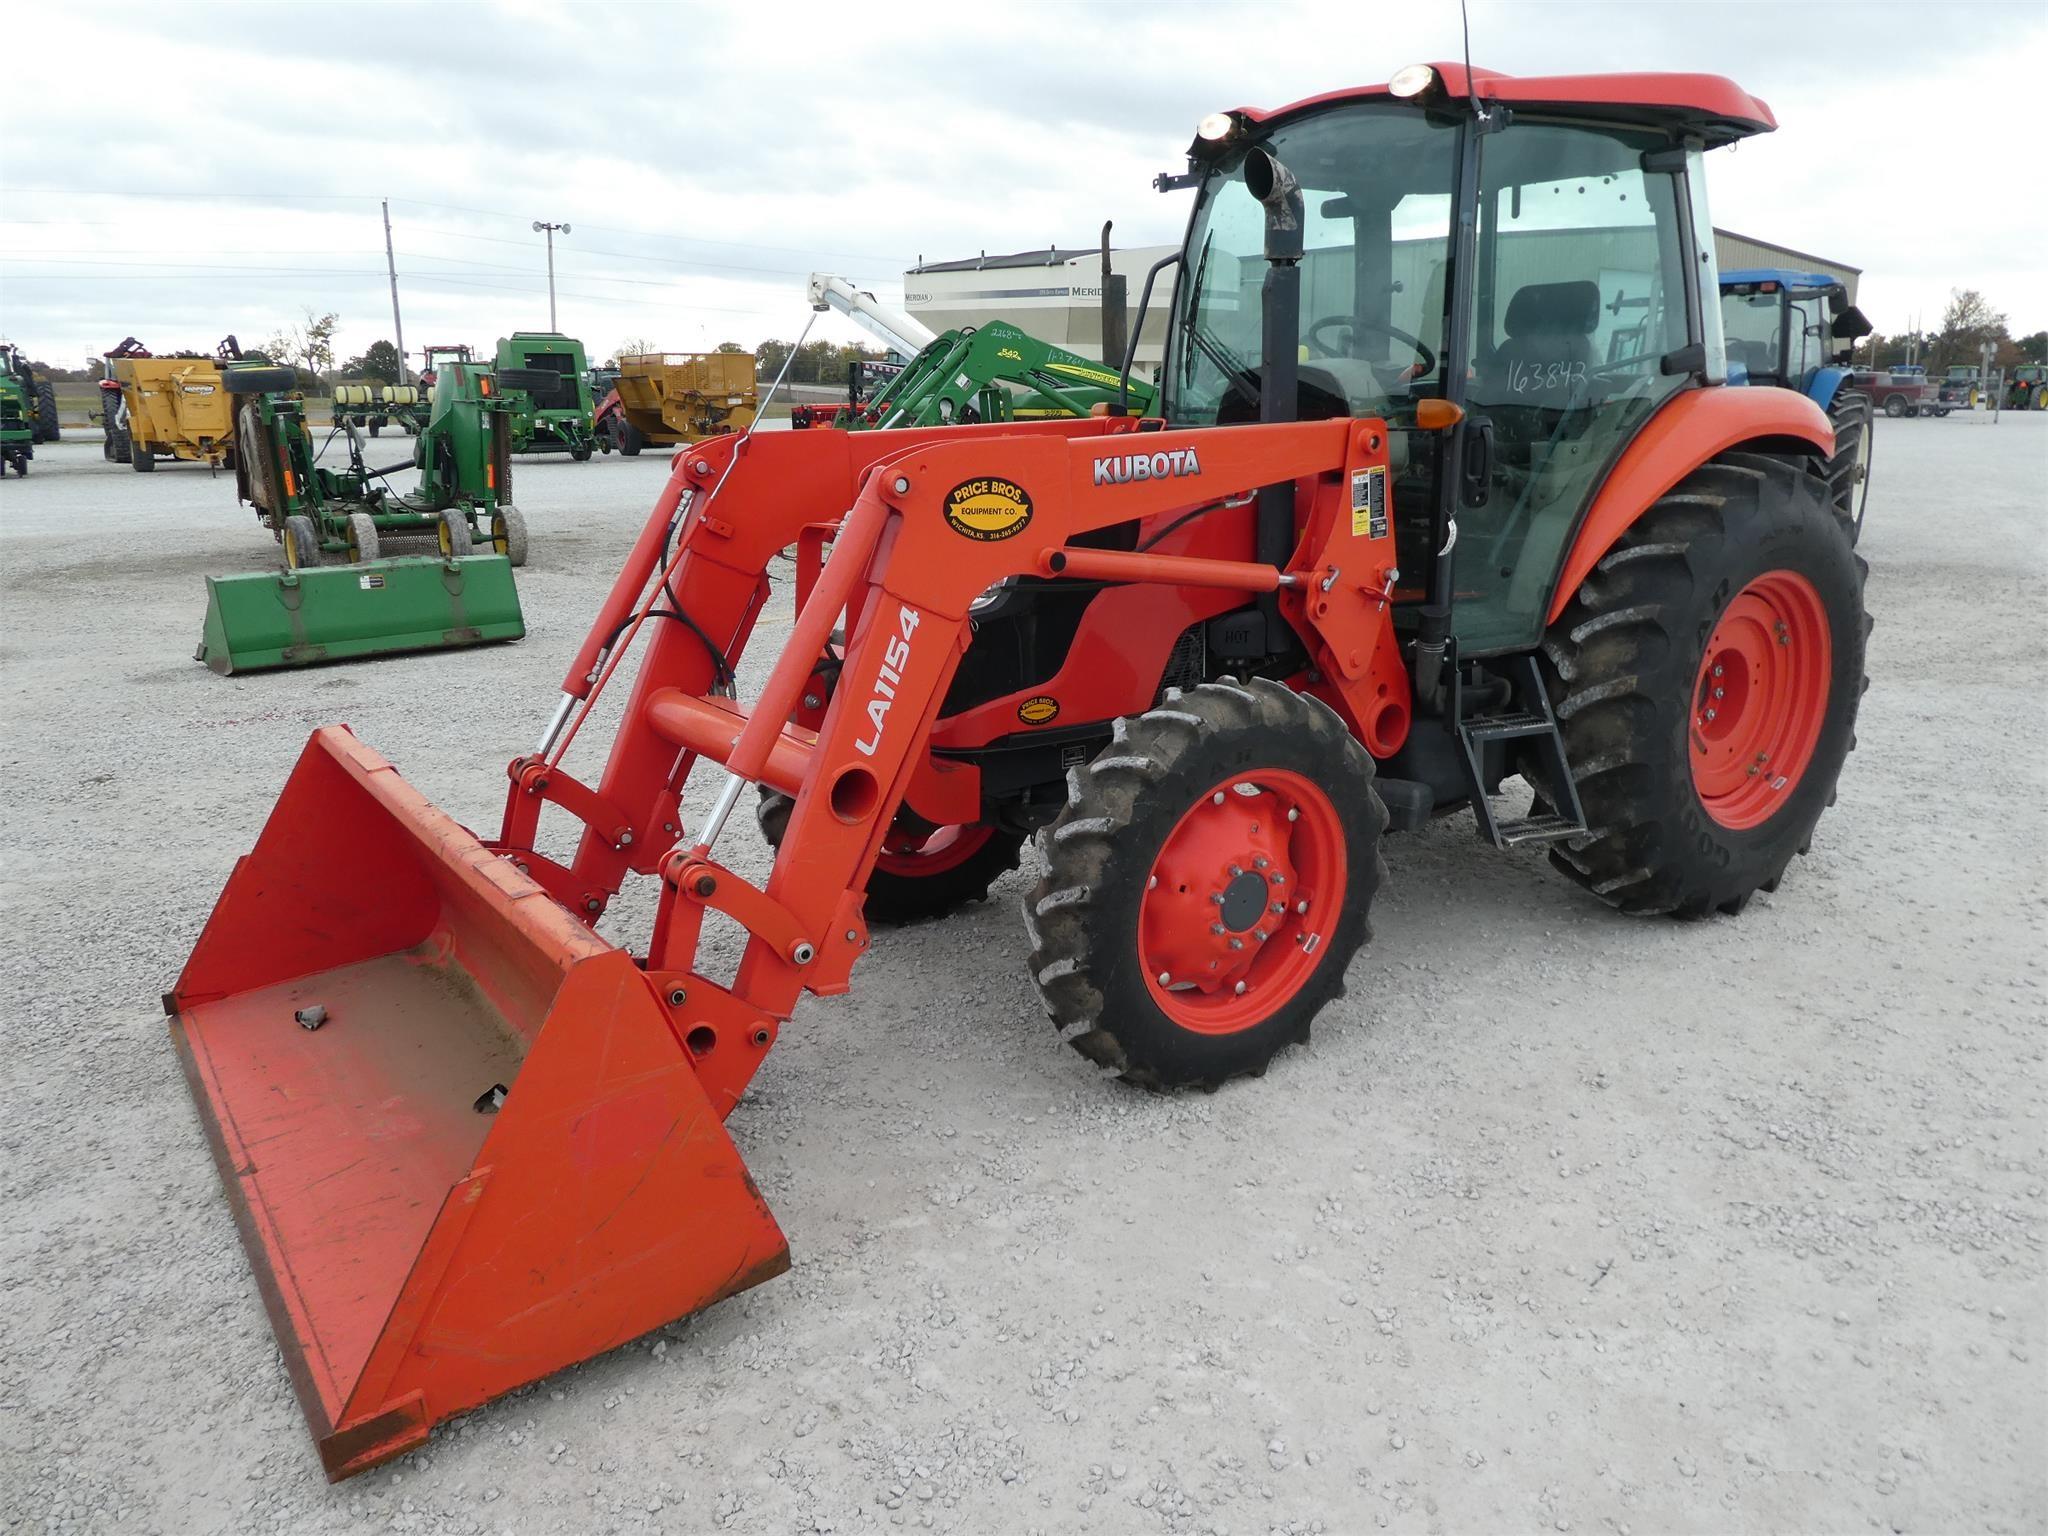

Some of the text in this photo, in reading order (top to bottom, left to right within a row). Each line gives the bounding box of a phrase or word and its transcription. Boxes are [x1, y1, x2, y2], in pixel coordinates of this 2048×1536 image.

[1506, 360, 1588, 394] 163842
[1094, 448, 1201, 486] KUBOTA
[954, 481, 1023, 503] PRICE BROS.
[961, 507, 1017, 515] EQUIPMENT CO.
[1225, 629, 1250, 644] HOT
[855, 605, 920, 756] LA1154
